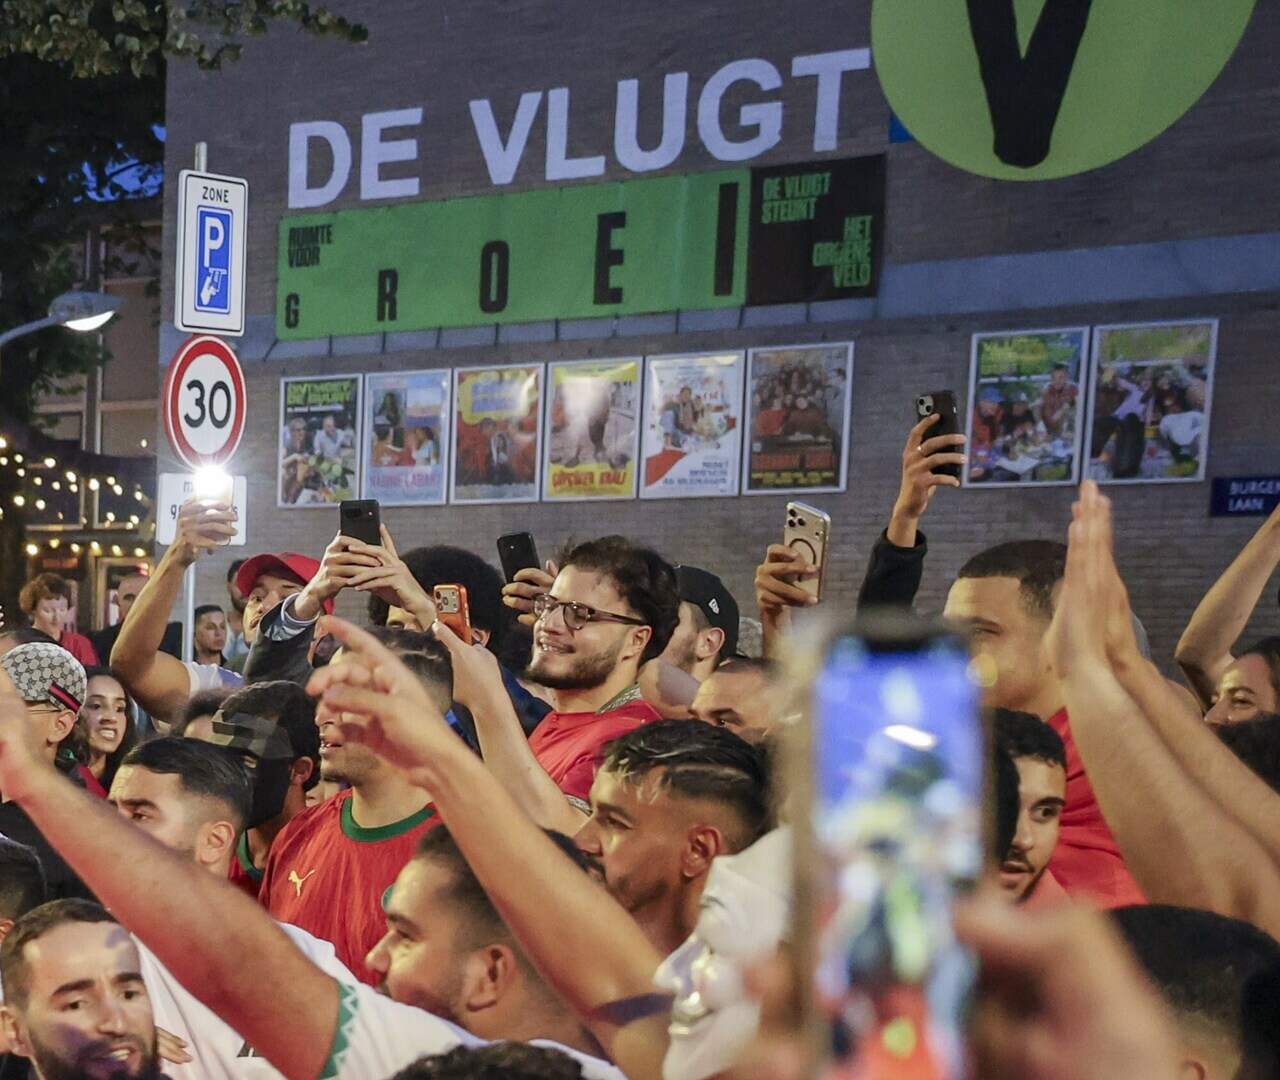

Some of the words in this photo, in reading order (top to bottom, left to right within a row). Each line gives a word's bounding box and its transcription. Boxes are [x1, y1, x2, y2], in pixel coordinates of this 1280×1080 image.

[966, 0, 1091, 169] V
[288, 107, 423, 210] DE
[469, 47, 871, 185] VLUGT
[202, 186, 229, 204] ZONE
[762, 177, 782, 200] DE
[289, 224, 333, 245] RUIMTE
[844, 215, 873, 240] HET
[204, 216, 226, 267] P
[288, 246, 321, 269] VOOR
[184, 379, 232, 430] 30
